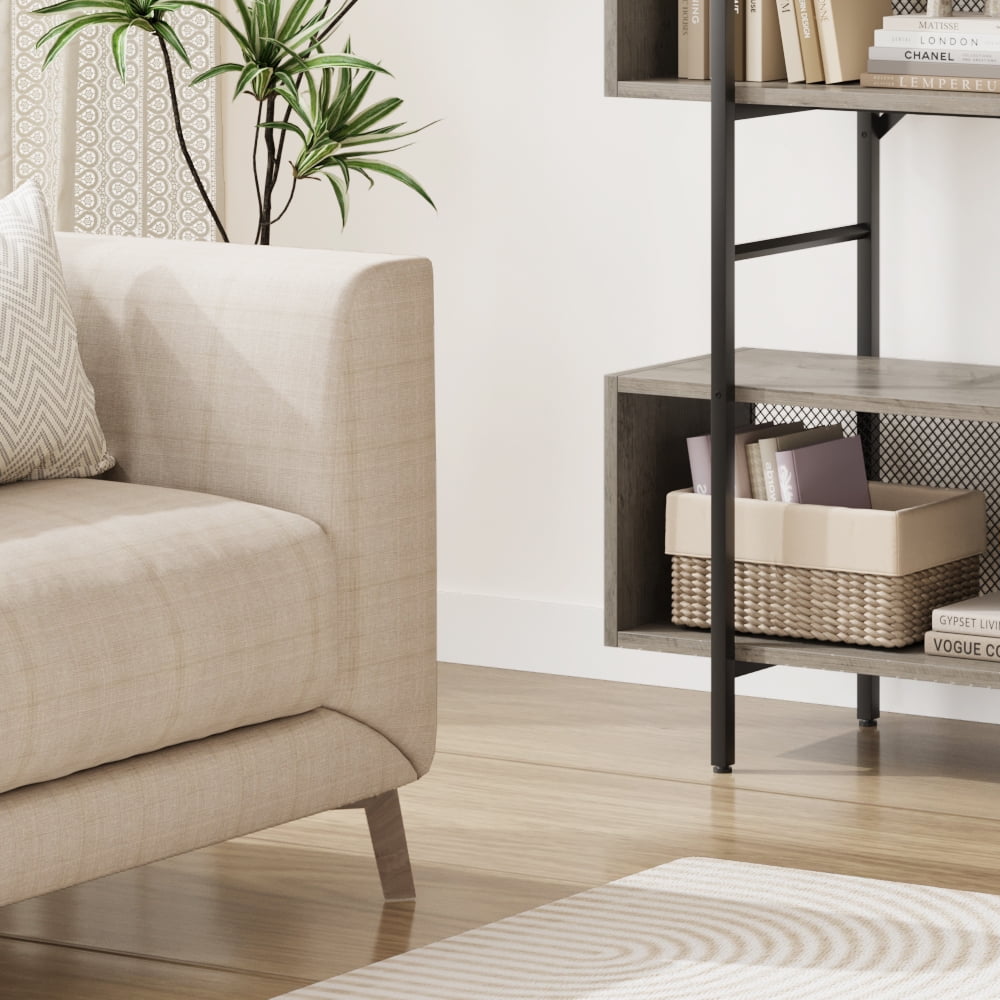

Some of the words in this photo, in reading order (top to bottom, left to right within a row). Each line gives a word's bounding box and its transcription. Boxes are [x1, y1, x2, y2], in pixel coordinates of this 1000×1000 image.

[919, 20, 959, 31] MATISSE
[920, 36, 979, 47] LONDON
[904, 50, 955, 62] CHANEL
[939, 615, 977, 629] GYPSET
[933, 638, 981, 656] VOGUE
